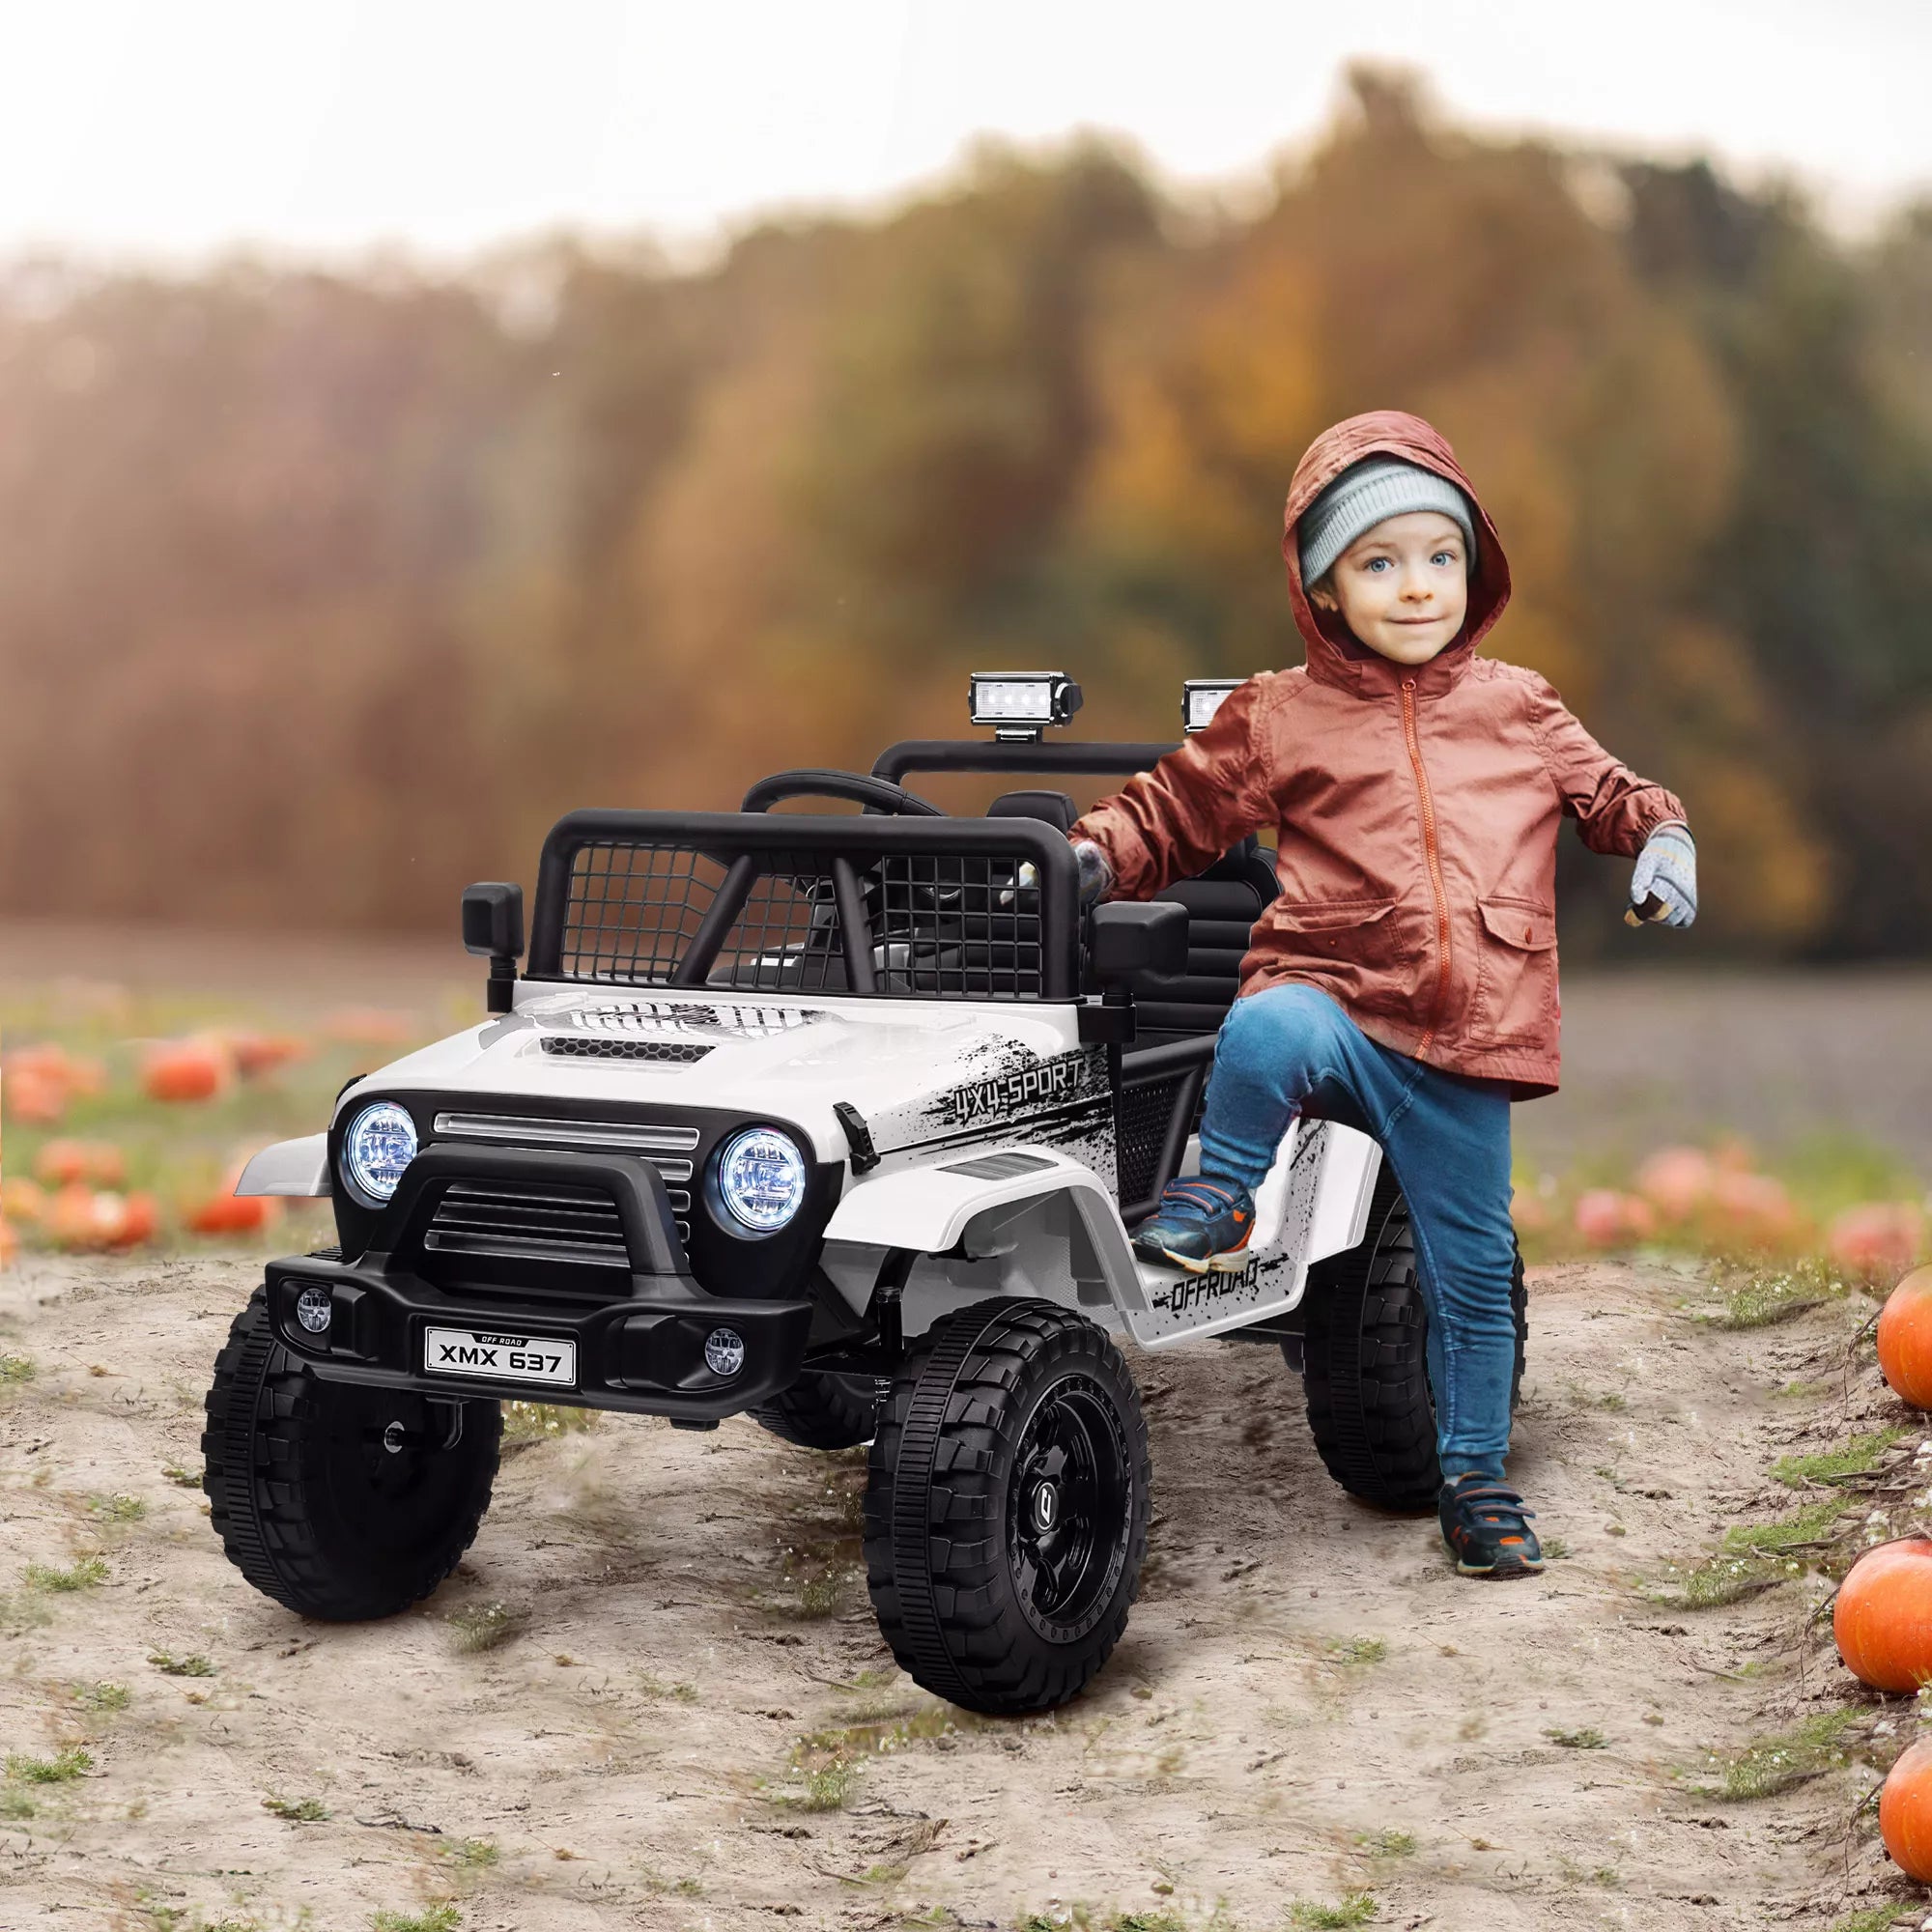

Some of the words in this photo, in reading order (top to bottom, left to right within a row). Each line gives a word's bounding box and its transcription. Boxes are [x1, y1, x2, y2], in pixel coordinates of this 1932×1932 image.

[1171, 1257, 1260, 1312] OFFROAD
[498, 1337, 523, 1347] ROAD
[439, 1344, 498, 1367] XMX
[509, 1351, 562, 1373] 637
